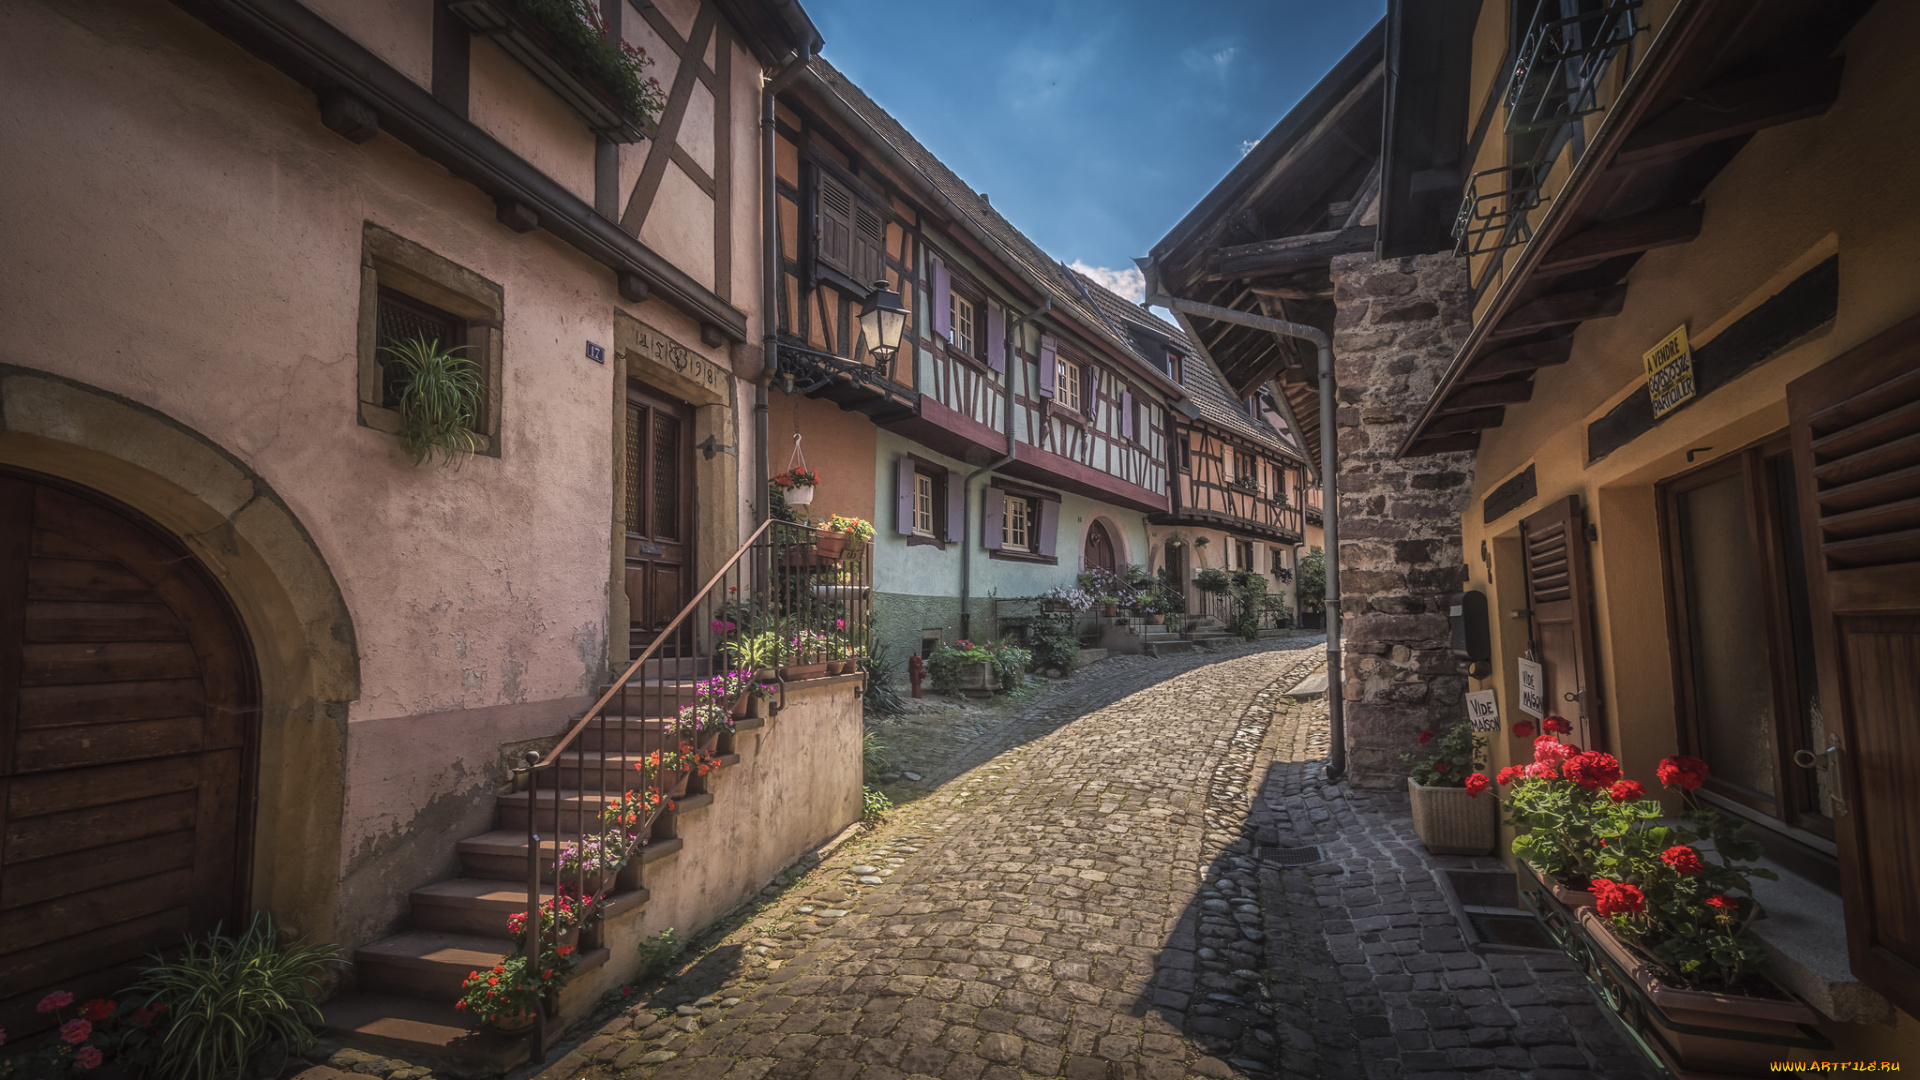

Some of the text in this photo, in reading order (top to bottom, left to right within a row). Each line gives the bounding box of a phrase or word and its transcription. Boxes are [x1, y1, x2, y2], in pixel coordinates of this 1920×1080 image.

[591, 345, 600, 359] 17
[1647, 337, 1680, 374] A VENDRE
[1470, 699, 1494, 715] VIDE
[1471, 716, 1500, 732] MAISON
